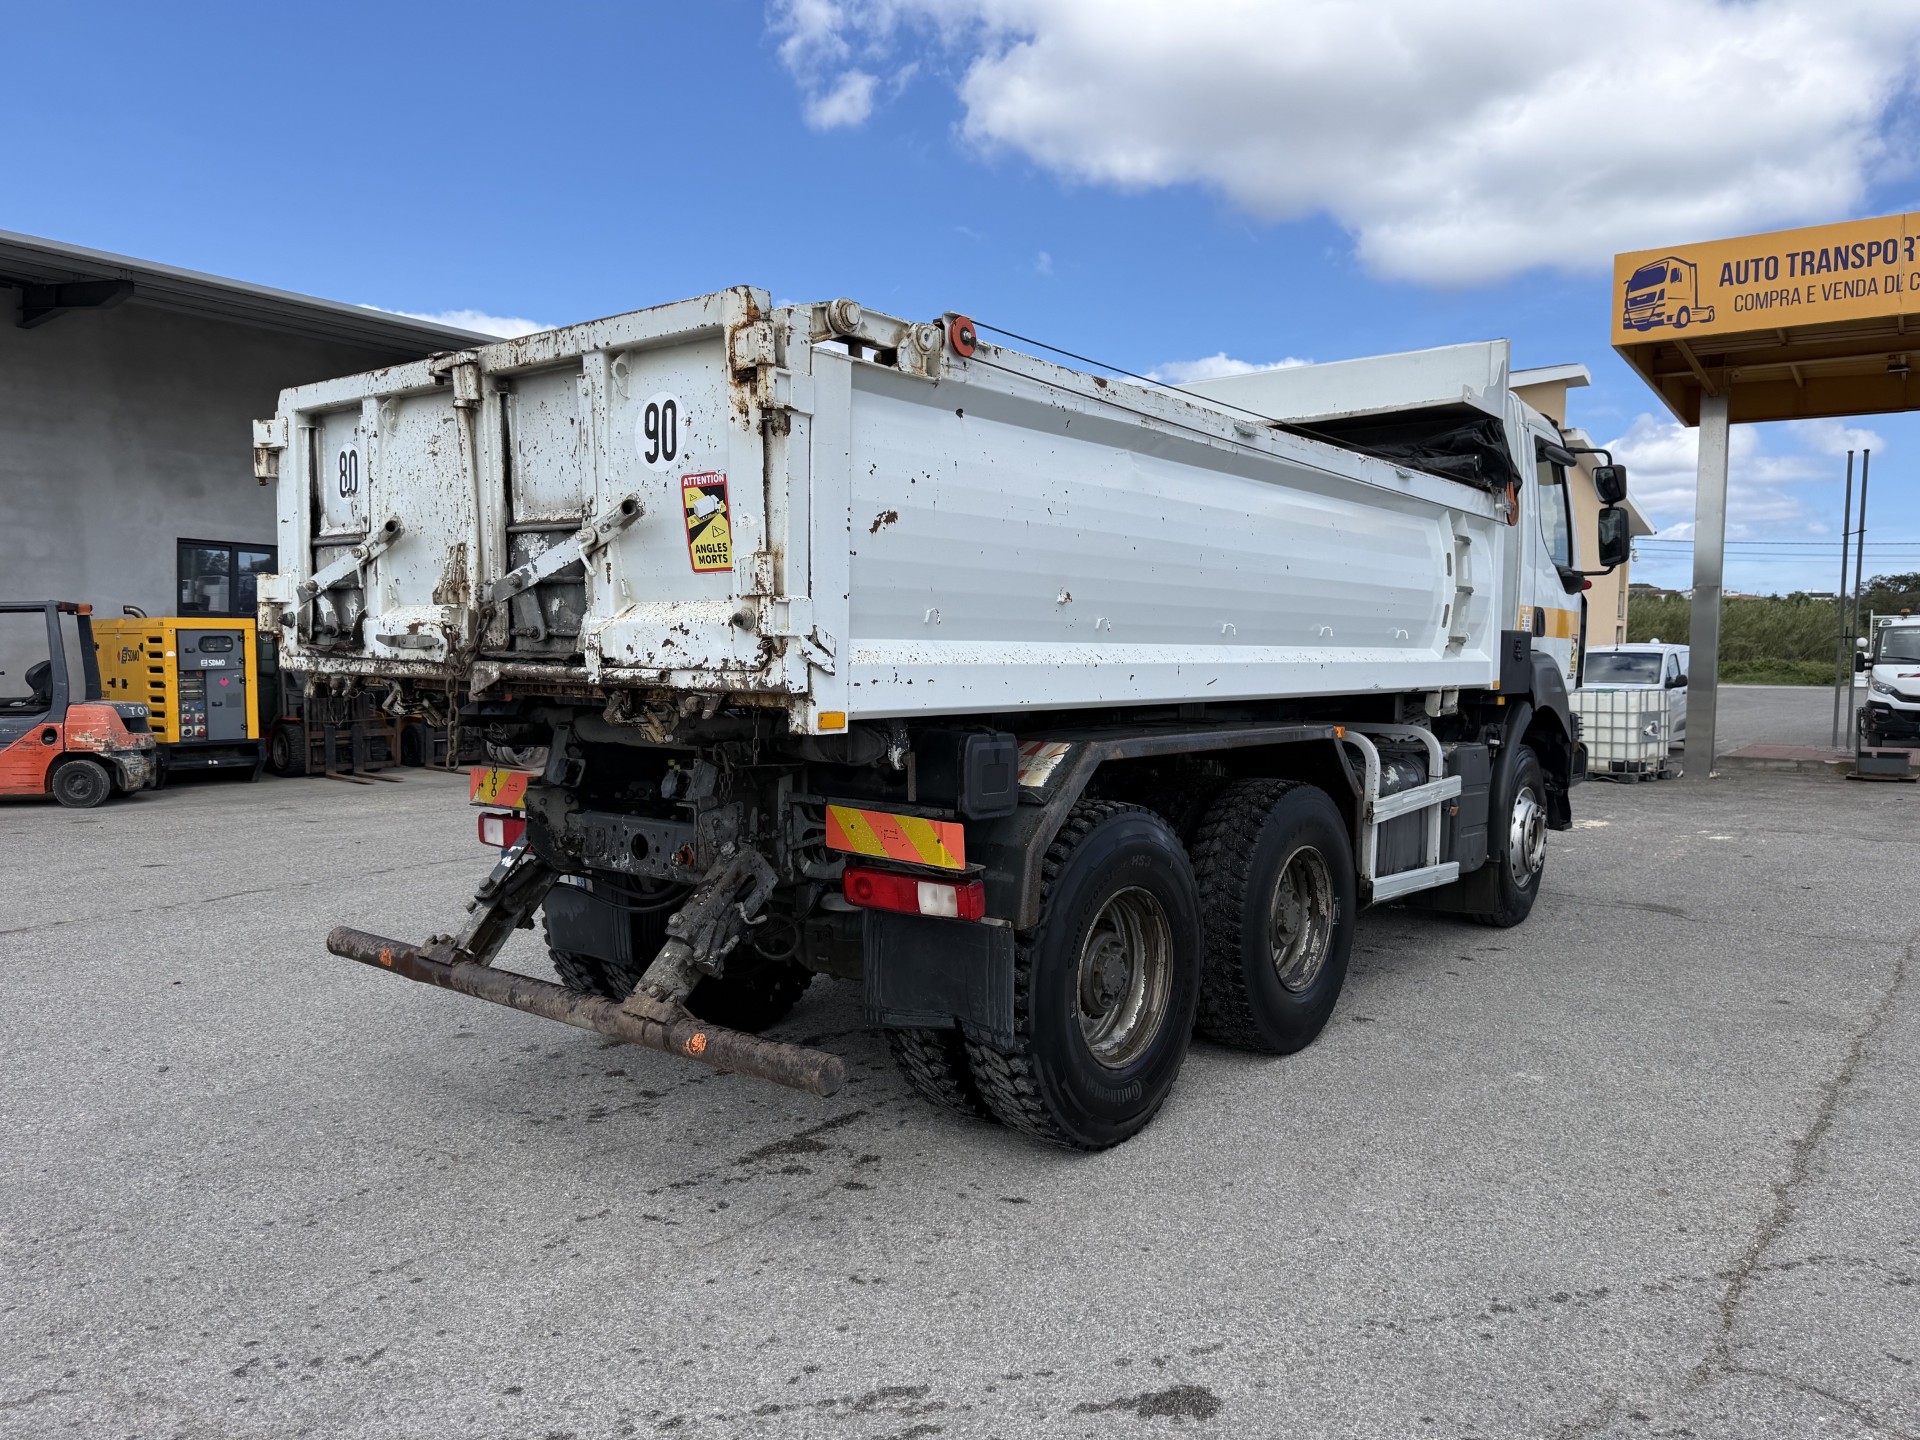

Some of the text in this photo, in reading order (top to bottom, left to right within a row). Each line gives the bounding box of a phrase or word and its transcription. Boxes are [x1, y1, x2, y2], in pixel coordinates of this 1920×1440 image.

[1719, 255, 1779, 287] AUTO
[1734, 290, 1801, 312] COMPRA
[1807, 285, 1816, 303] E
[1821, 277, 1878, 301] VENDA
[644, 399, 677, 464] 90
[340, 450, 358, 498] 80
[683, 474, 724, 486] ATTENTION
[695, 542, 728, 554] ANGLES
[698, 553, 729, 565] MORTS
[128, 649, 139, 661] SDMO
[1131, 855, 1152, 868] HS3
